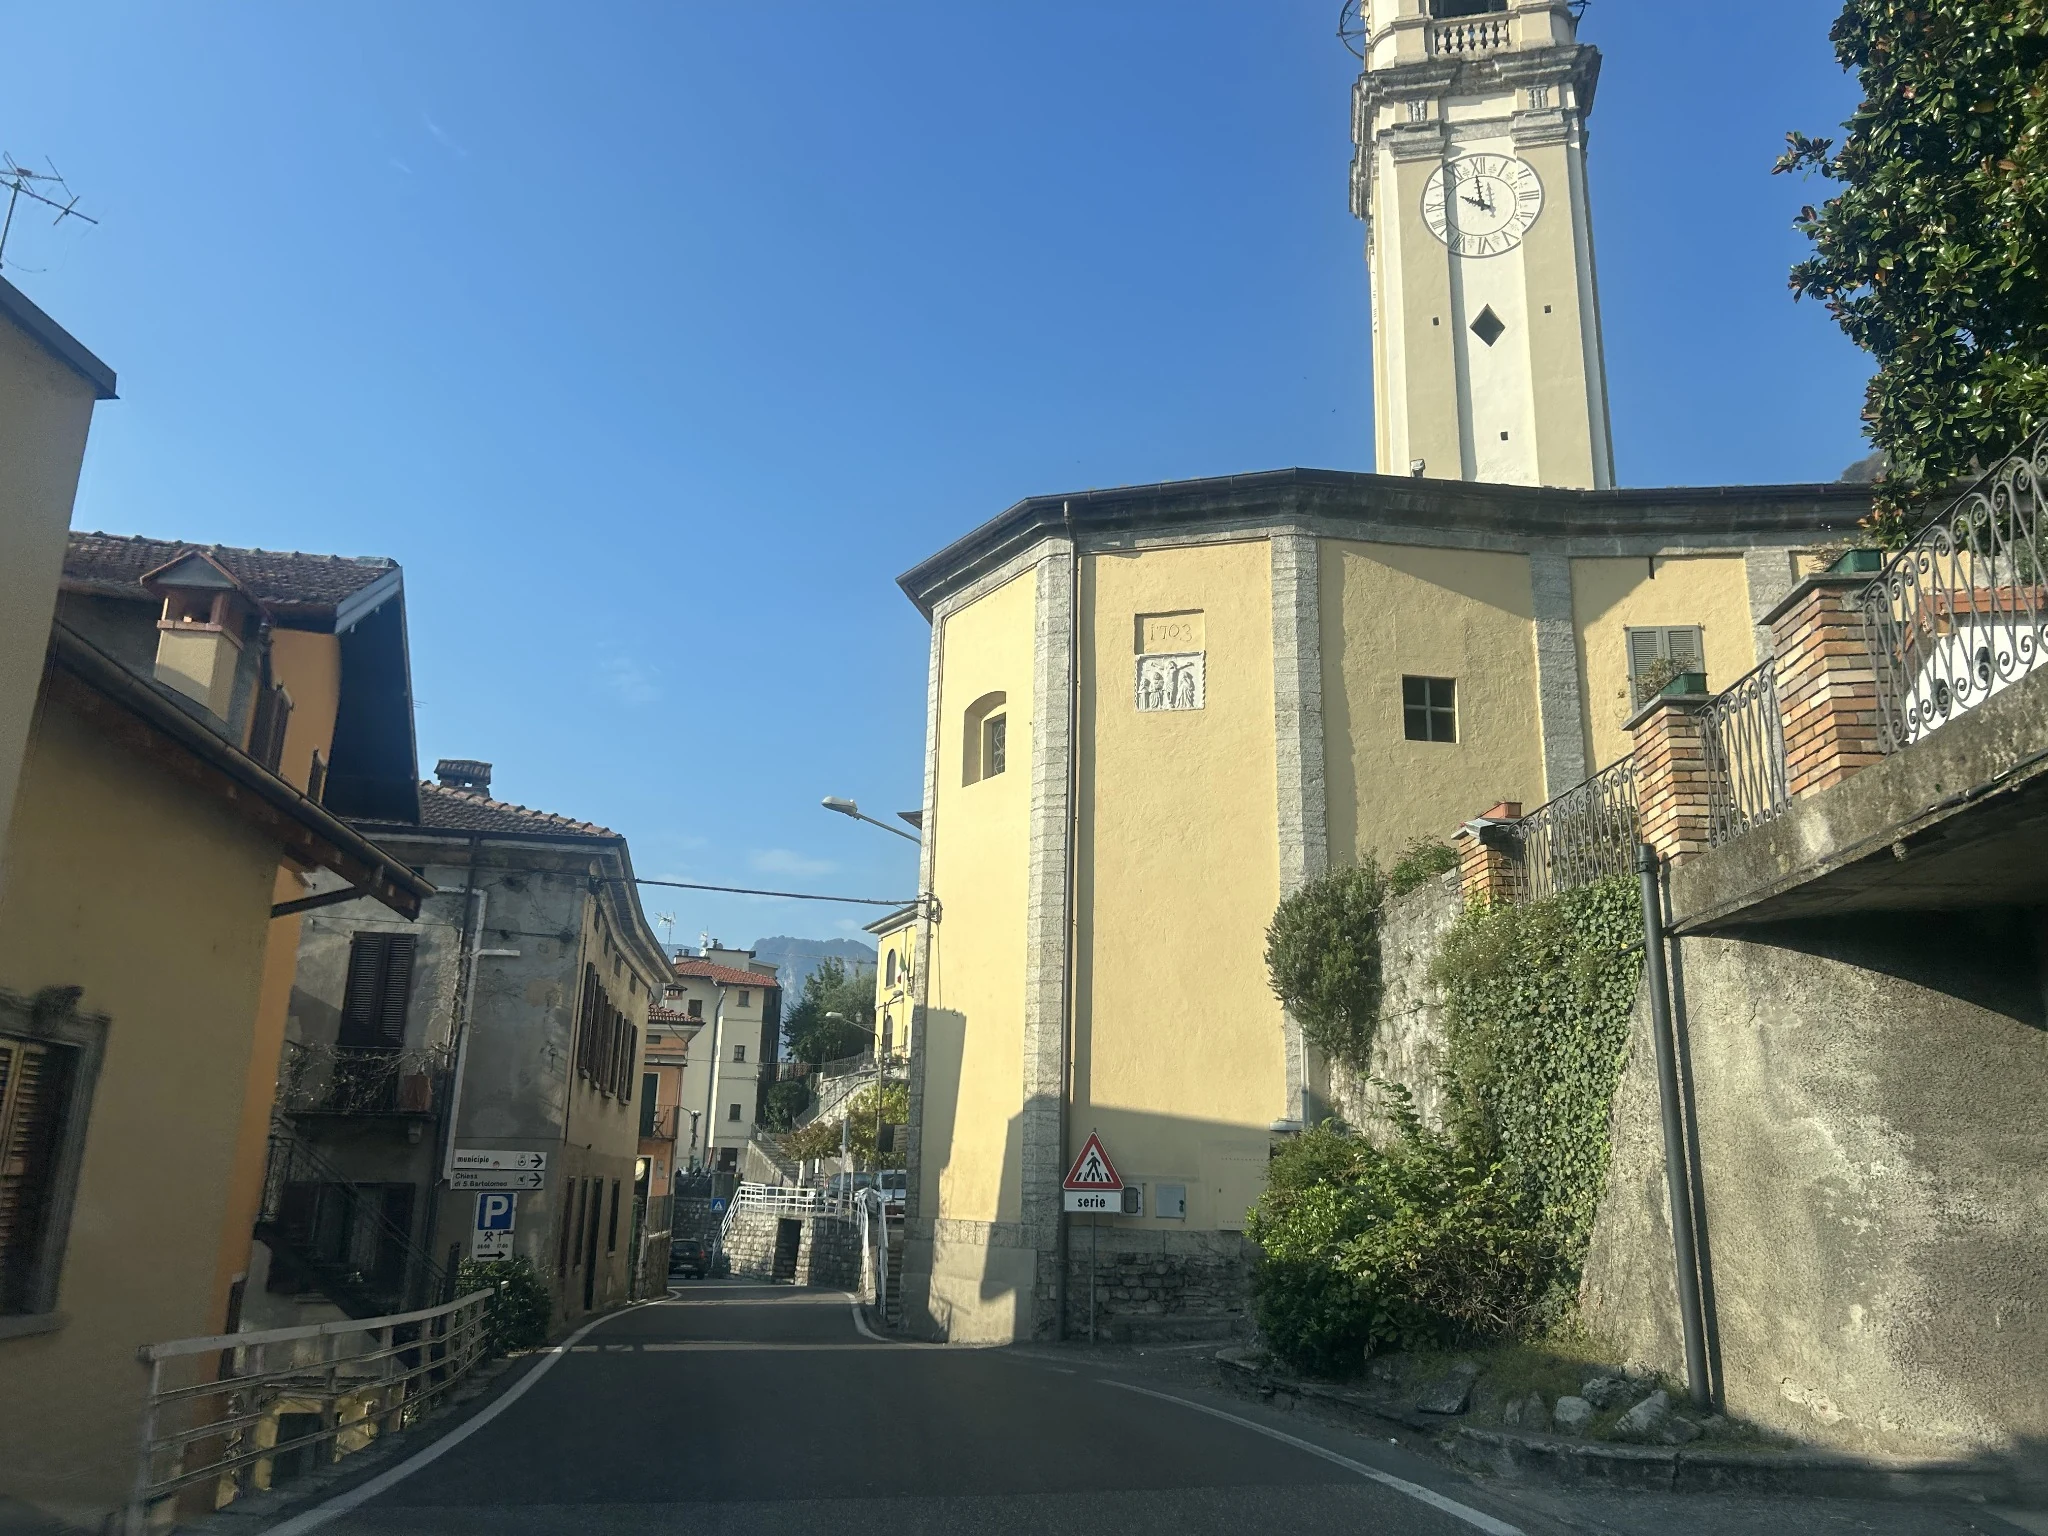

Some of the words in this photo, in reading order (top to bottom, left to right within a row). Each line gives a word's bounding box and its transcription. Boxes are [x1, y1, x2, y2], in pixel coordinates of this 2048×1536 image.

[457, 1155, 489, 1164] municipio
[1077, 1194, 1106, 1208] serie
[484, 1195, 509, 1228] P
